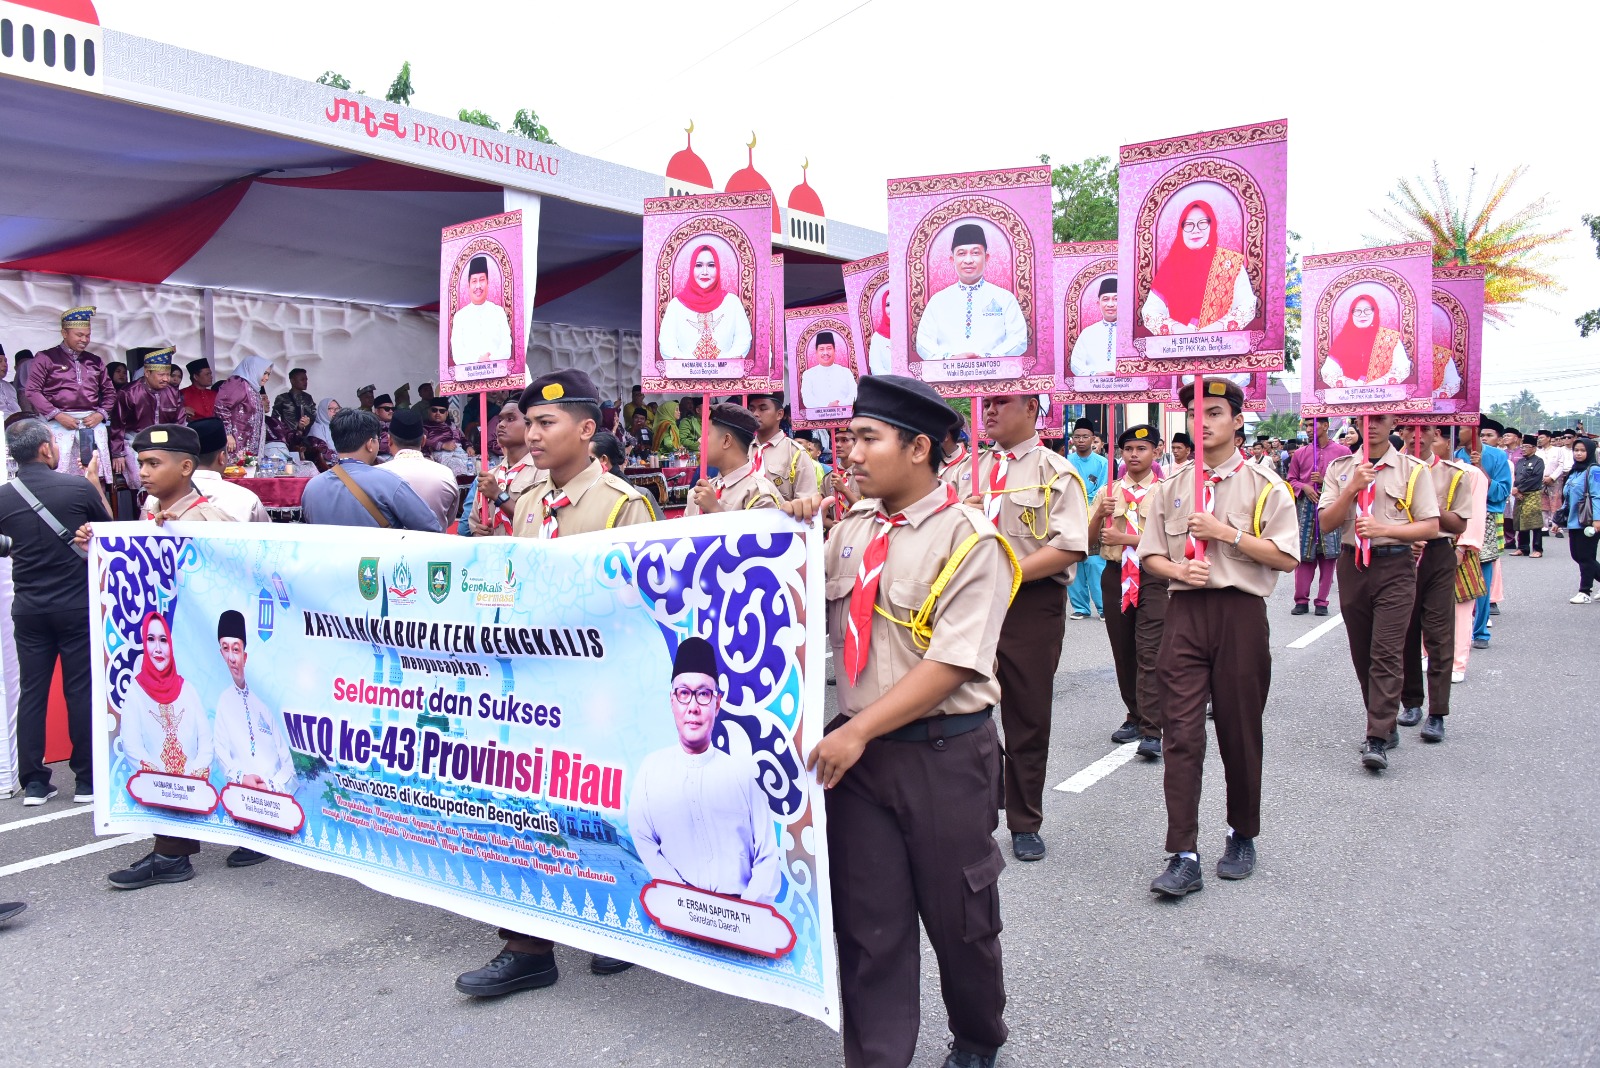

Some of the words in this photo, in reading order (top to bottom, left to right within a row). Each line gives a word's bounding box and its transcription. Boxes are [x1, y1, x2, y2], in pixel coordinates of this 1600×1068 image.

[413, 122, 511, 165] PROVINSI
[515, 149, 560, 176] RIAU
[1162, 346, 1177, 354] Ketua
[1197, 344, 1207, 352] Kab.
[1208, 343, 1232, 352] Bengkalis
[1179, 337, 1189, 345] SITI
[1190, 336, 1210, 345] AISYAH,
[1211, 336, 1223, 344] S.Ag
[689, 368, 701, 376] Bupati
[701, 368, 719, 376] Bengkalis
[957, 361, 975, 369] BAGUS
[976, 360, 1001, 368] SANTOSO
[960, 369, 974, 377] Bupati
[975, 368, 997, 377] Bengkalis
[303, 610, 368, 643] KAFILAH
[370, 618, 476, 654] KABUPATEN
[481, 626, 604, 658] BENGKALIS
[400, 654, 482, 677] mengucapkan
[333, 677, 425, 711] Selamat
[429, 687, 472, 717] dan
[478, 692, 561, 728] Sukses
[283, 712, 334, 757] MTQ
[340, 719, 416, 772] ke-43
[421, 731, 544, 795] Provinsi
[550, 748, 624, 811] Riau
[335, 773, 369, 793] Tahun
[370, 781, 397, 800] 2025
[399, 788, 411, 803] di
[413, 790, 485, 820] Kabupaten
[487, 806, 558, 832] Bengkalis
[436, 821, 444, 833] di
[446, 827, 459, 836] atas
[489, 832, 534, 852] Nilai-Nilai
[440, 838, 459, 854] Maju
[461, 843, 475, 856] dan
[476, 846, 510, 862] Sejahtera
[511, 856, 529, 867] serta
[531, 857, 562, 875] Unggul
[563, 863, 573, 876] di
[574, 865, 616, 883] Indonesia
[677, 896, 685, 908] dr.
[686, 898, 709, 915] ERSAN
[708, 904, 741, 922] SAPUTRA
[740, 912, 752, 925] TH
[688, 911, 718, 928] Sekretaris
[718, 918, 741, 934] Daerah
